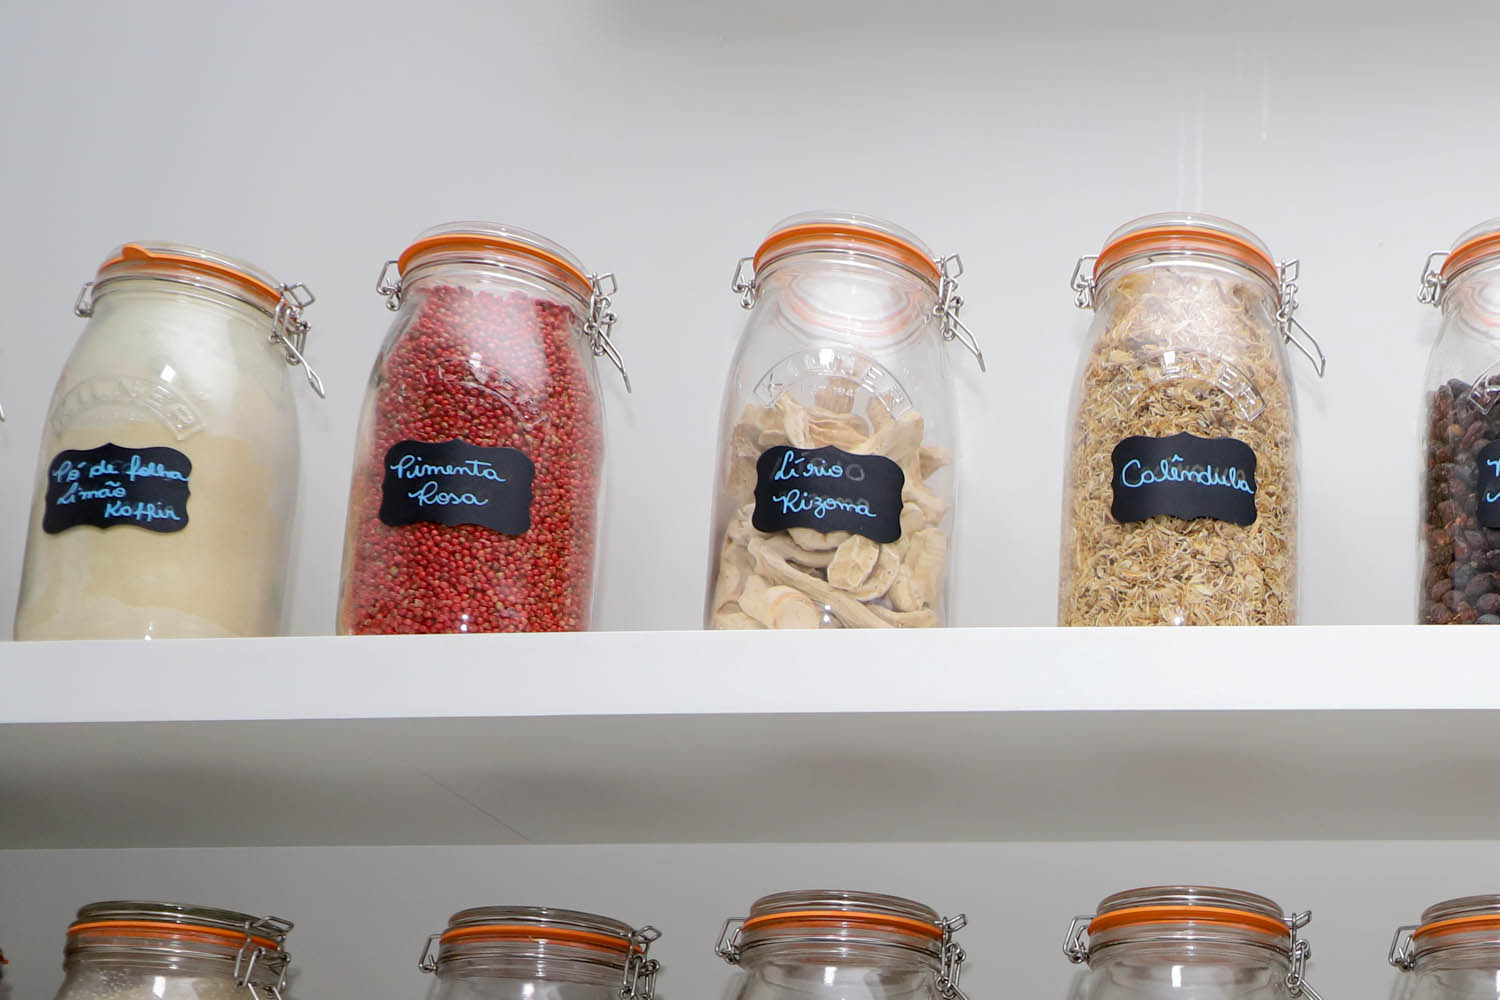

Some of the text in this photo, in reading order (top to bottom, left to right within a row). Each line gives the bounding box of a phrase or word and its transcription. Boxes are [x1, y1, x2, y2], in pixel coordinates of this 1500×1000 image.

[89, 460, 120, 478] de
[390, 455, 507, 482] Pimenta
[1122, 454, 1254, 494] Calêndula
[408, 481, 489, 506] Rosa
[773, 489, 876, 518] Rizoma
